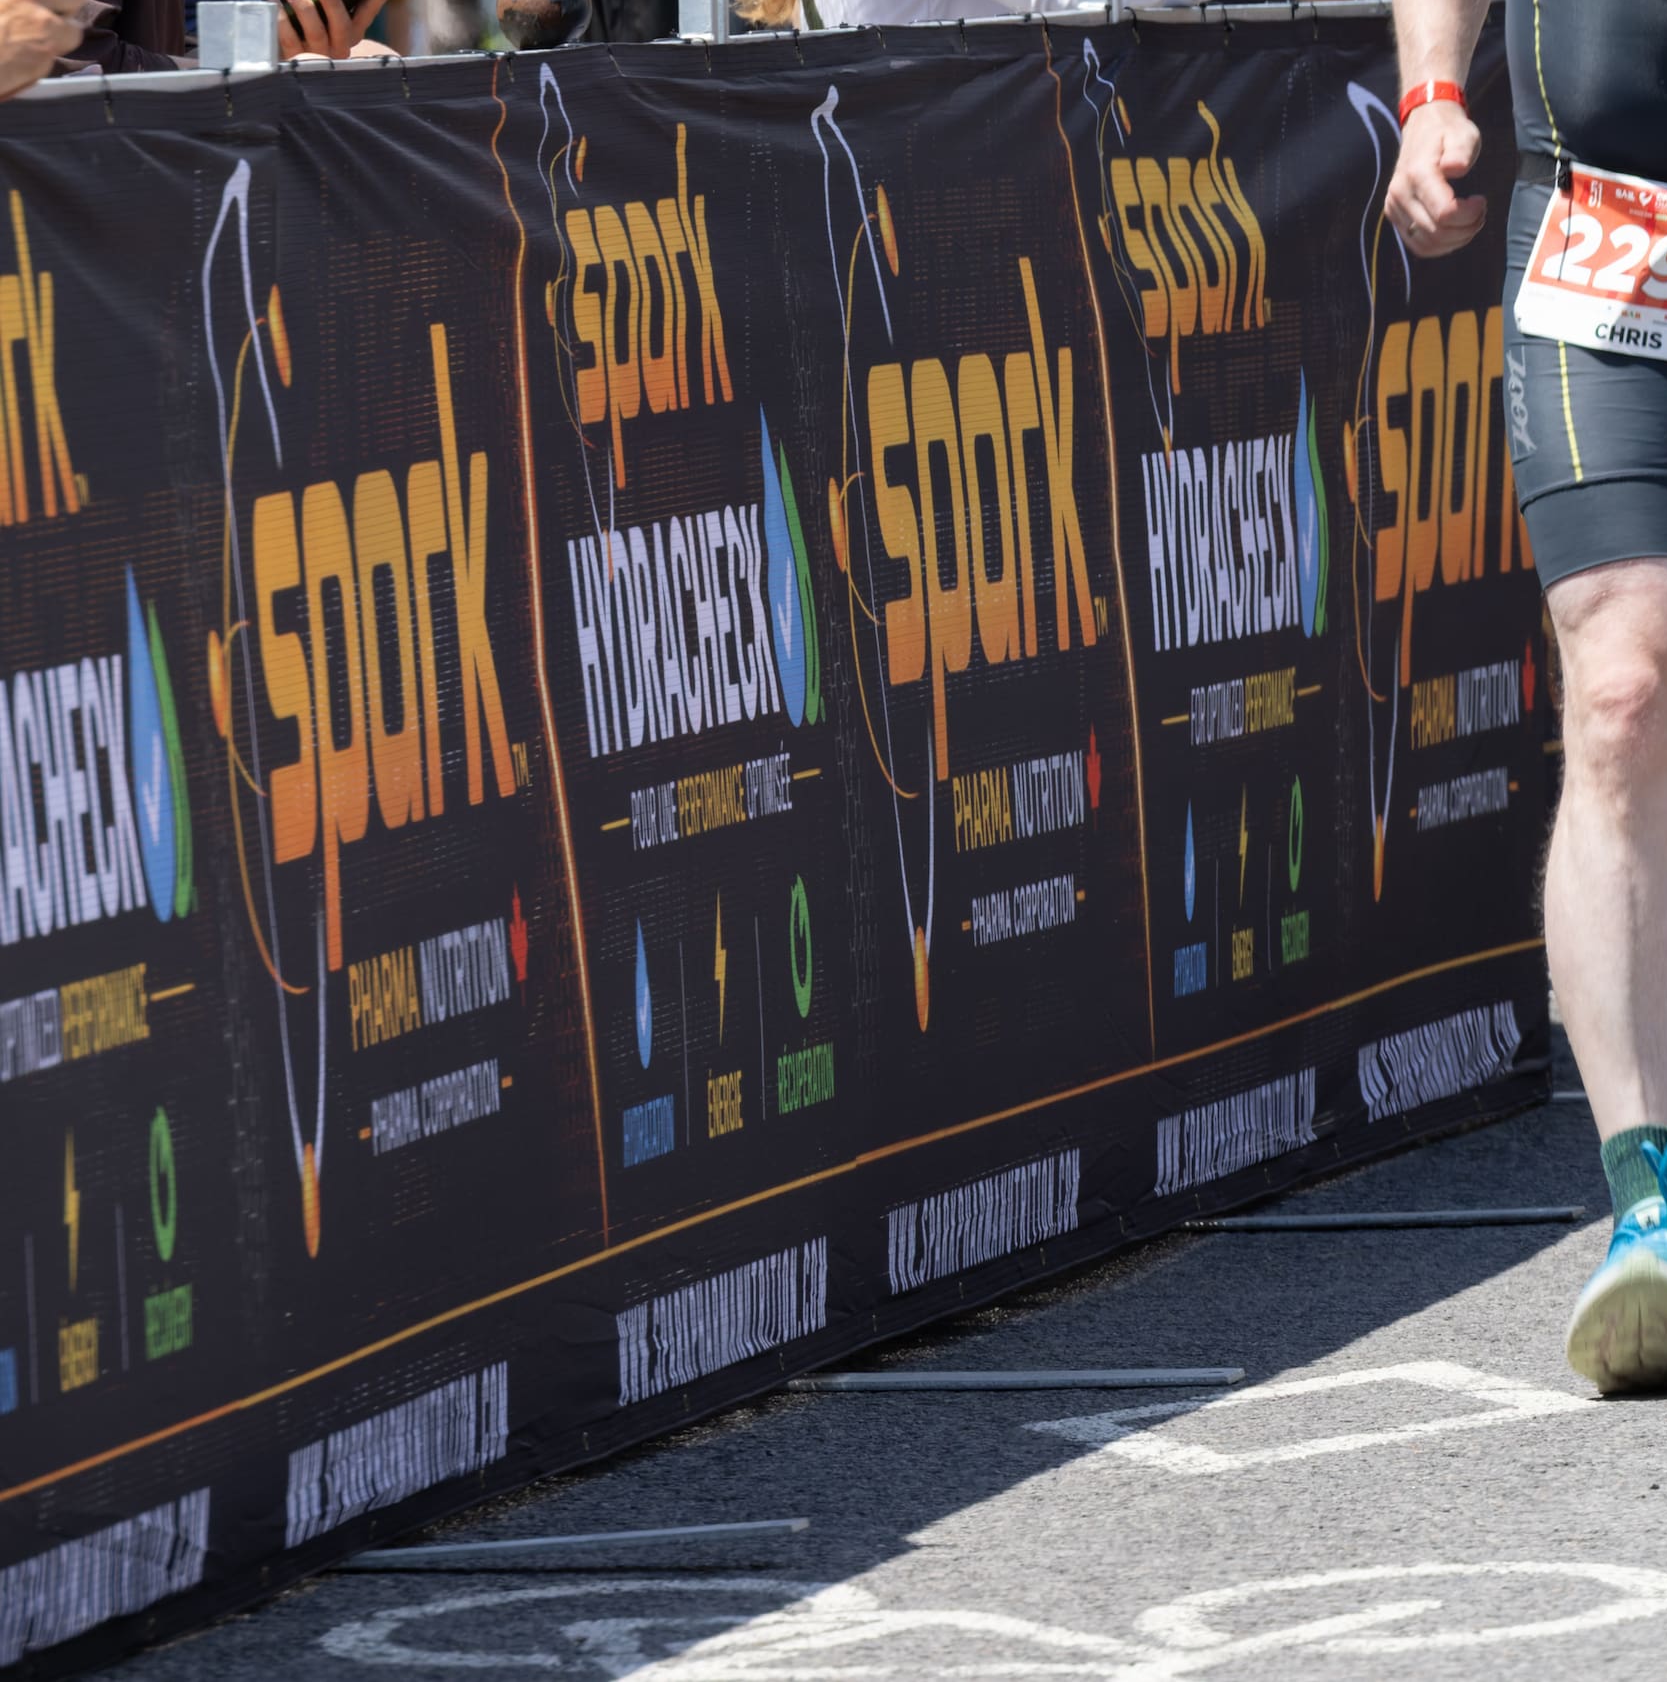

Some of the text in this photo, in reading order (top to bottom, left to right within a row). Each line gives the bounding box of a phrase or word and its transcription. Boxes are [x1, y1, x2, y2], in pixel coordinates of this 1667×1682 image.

[565, 122, 734, 490] spark
[1111, 99, 1266, 395] spark
[1595, 323, 1663, 350] CHRIS
[868, 257, 1097, 781] spark
[1141, 433, 1300, 652] HYDRACHECK
[253, 323, 517, 972] spark
[568, 503, 781, 759] HYDRACHECK
[1411, 659, 1520, 751] PHARMA NUTRITION
[630, 739, 793, 851] POUR UNE PERFORMANCE OPTIMISÉE
[952, 749, 1086, 853] PHARMA NUTRITION
[972, 873, 1076, 948] PHARMA CORPORATION
[347, 916, 511, 1053] PHARMA NUTRITION
[707, 1068, 744, 1140] ÉNERGIE
